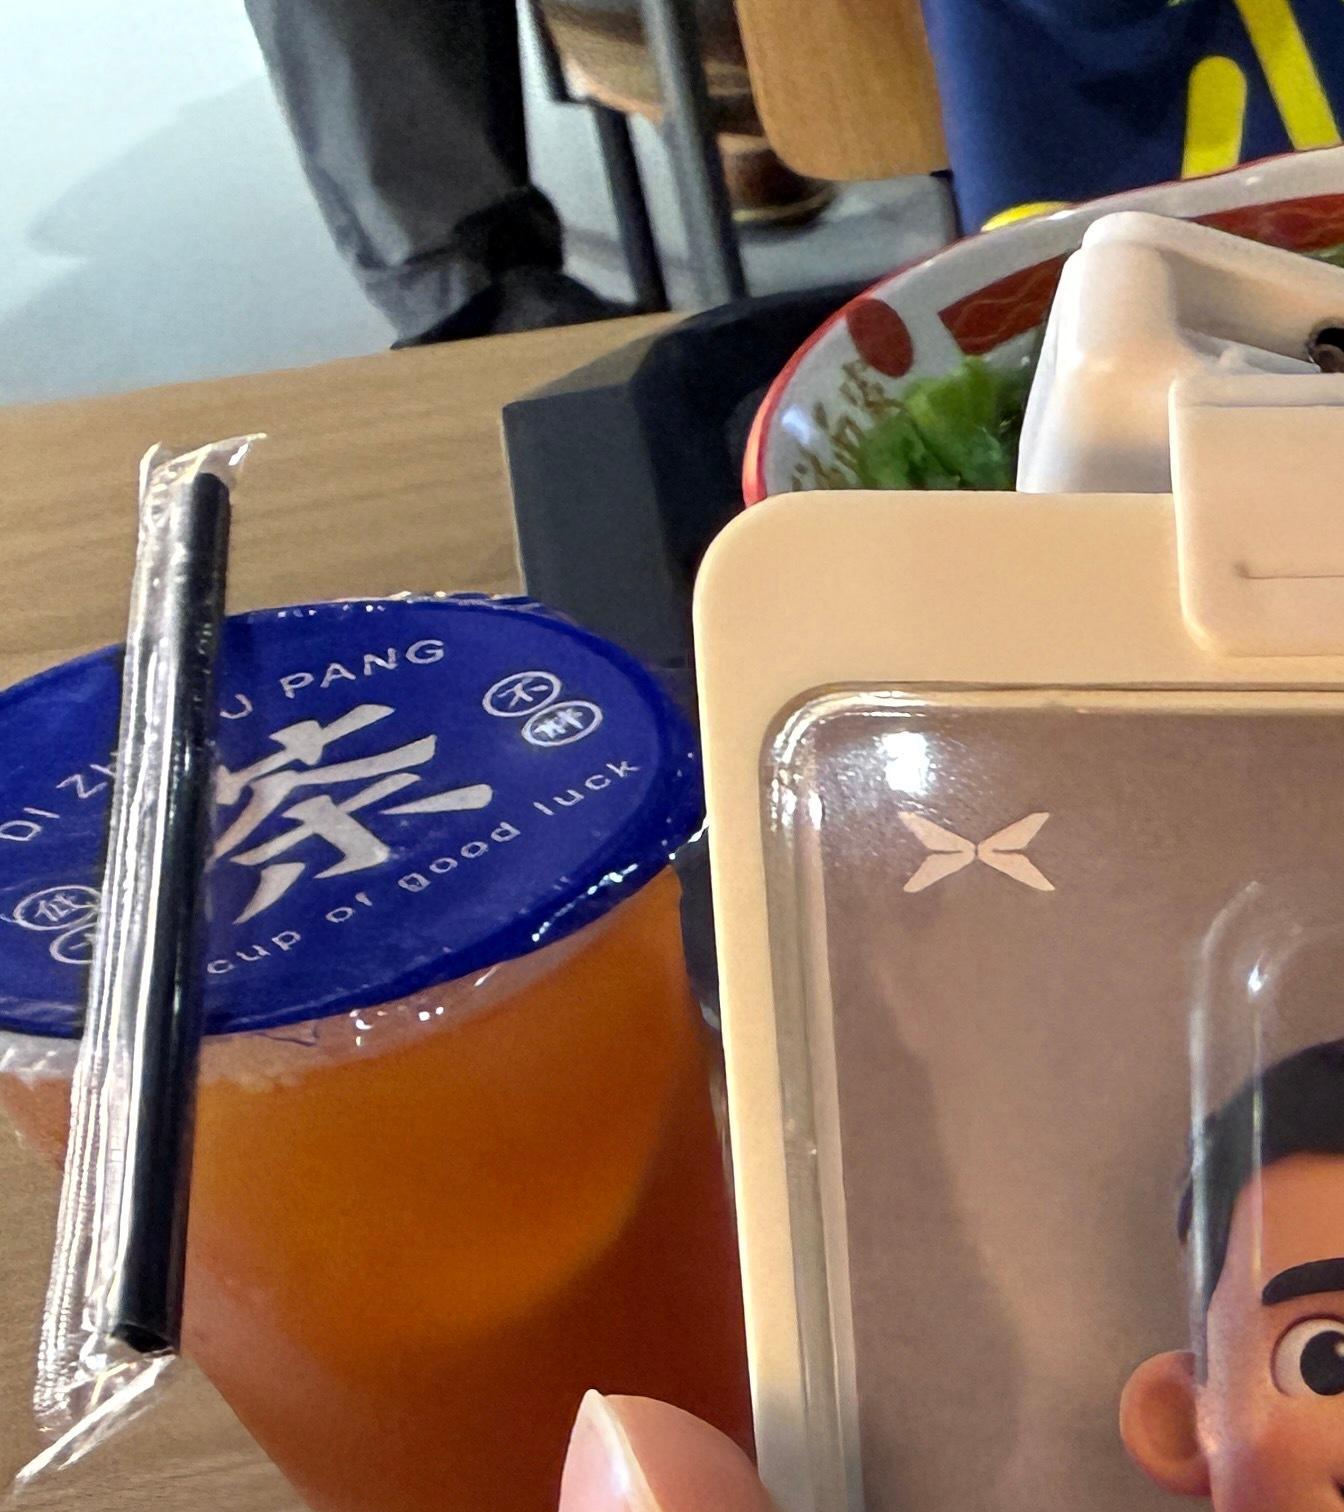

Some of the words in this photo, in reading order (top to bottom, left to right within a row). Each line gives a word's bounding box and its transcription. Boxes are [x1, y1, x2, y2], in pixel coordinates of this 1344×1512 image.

[0, 806, 60, 841] DI
[280, 639, 445, 698] PANG
[205, 704, 493, 924] 茶
[207, 930, 300, 974] cup
[398, 822, 521, 893] good
[532, 761, 641, 816] luck
